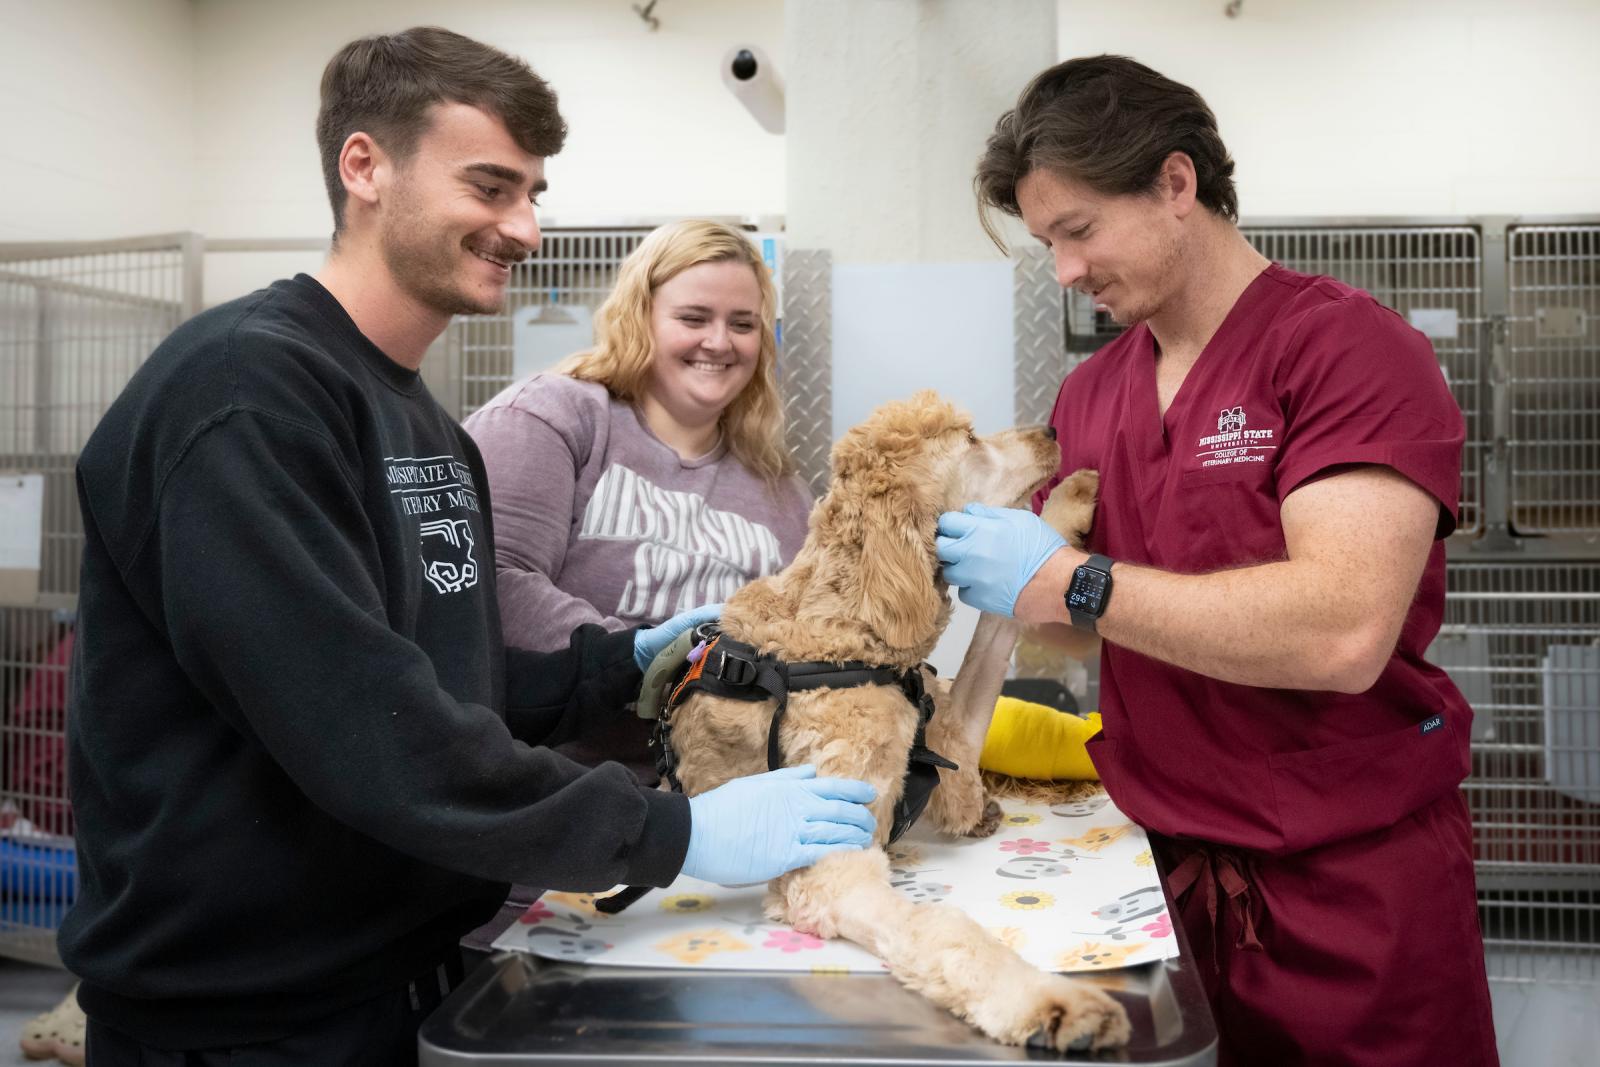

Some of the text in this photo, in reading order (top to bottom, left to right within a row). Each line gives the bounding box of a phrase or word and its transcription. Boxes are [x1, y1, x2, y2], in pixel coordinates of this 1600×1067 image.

[1199, 429, 1273, 447] MISSISSIPPI STATE
[1214, 448, 1248, 459] COLLEGE OF
[1202, 455, 1264, 467] VETERINARY MEDICINE
[1423, 718, 1441, 732] ADAR
